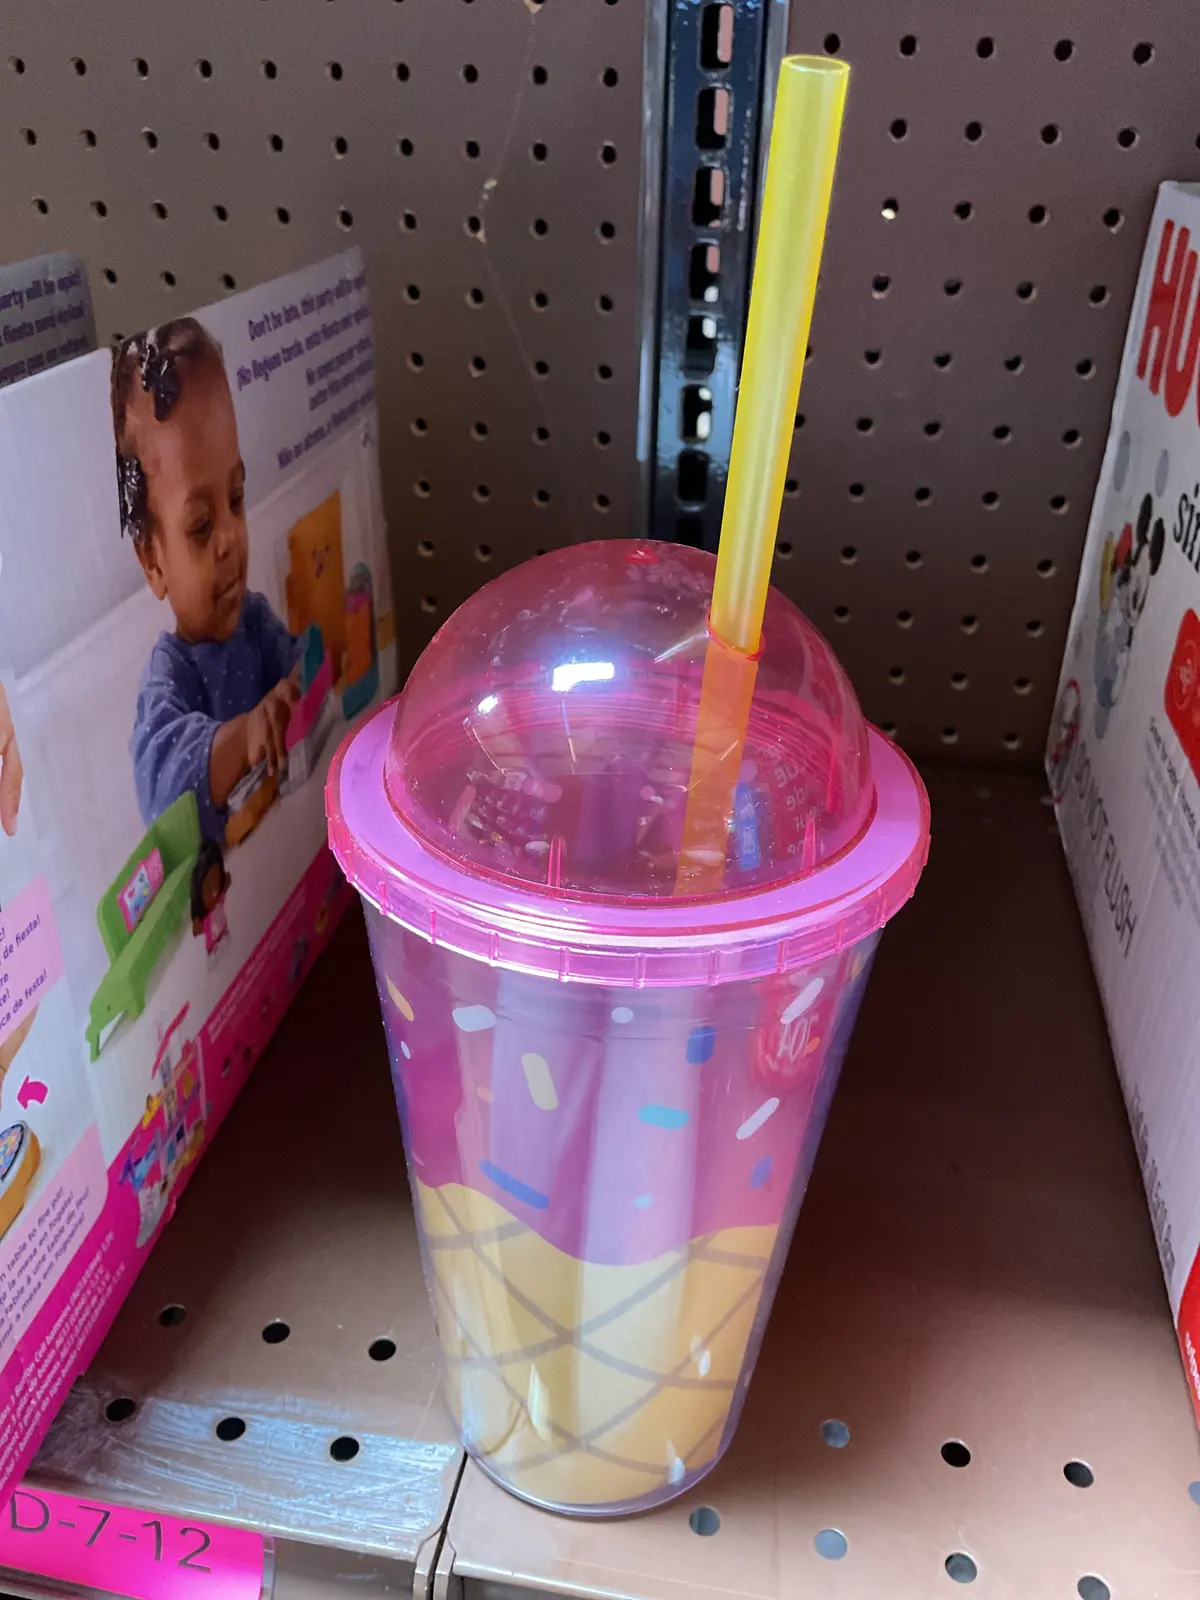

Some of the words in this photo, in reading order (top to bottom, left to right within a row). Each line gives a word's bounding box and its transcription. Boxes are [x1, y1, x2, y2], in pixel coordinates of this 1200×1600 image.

[3, 944, 14, 960] de
[13, 998, 24, 1013] de
[7, 1242, 27, 1272] table
[28, 1227, 37, 1242] to
[10, 1490, 212, 1574] D-7-12
